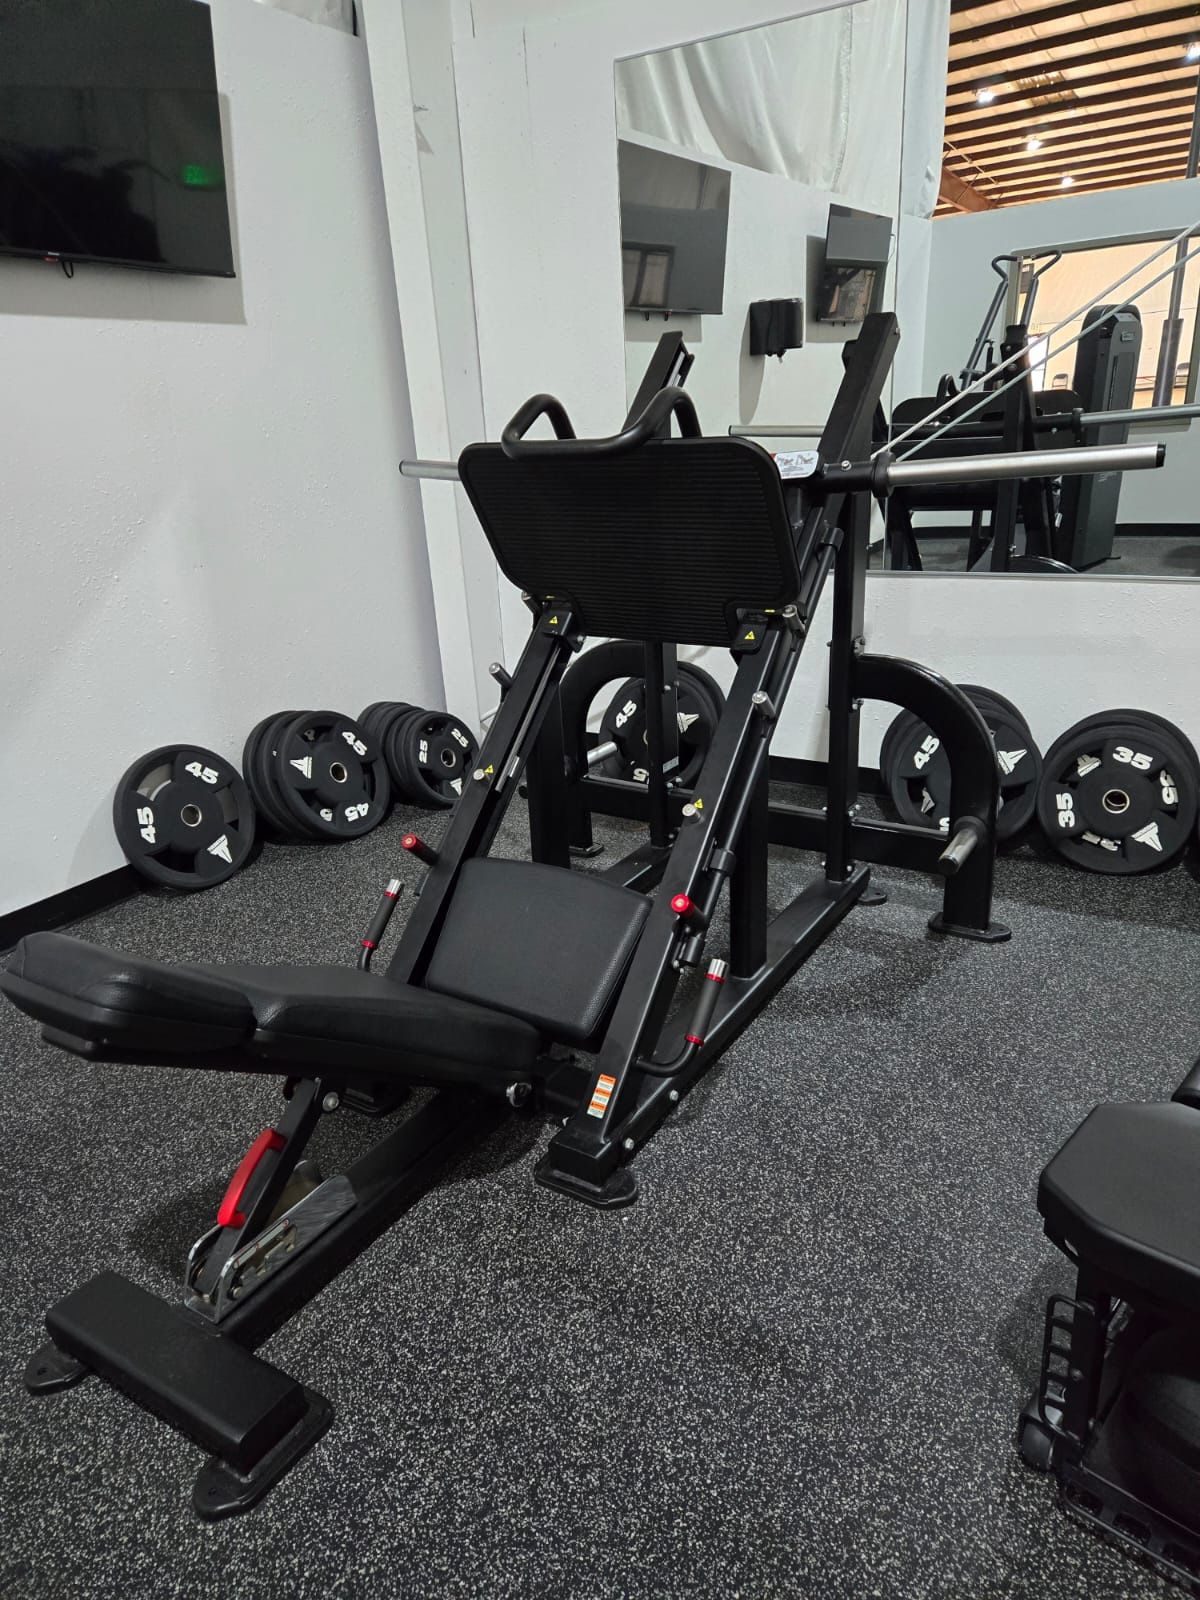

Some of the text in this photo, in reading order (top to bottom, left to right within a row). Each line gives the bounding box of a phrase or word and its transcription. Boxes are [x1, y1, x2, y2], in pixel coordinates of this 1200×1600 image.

[616, 700, 637, 728] 45
[342, 731, 368, 756] 45
[451, 728, 469, 748] 25
[418, 739, 428, 764] 25
[914, 735, 940, 770] 45
[1112, 746, 1154, 770] 35
[184, 761, 219, 785] 45
[344, 803, 369, 822] 45
[1055, 792, 1076, 828] 35
[136, 806, 156, 844] 45
